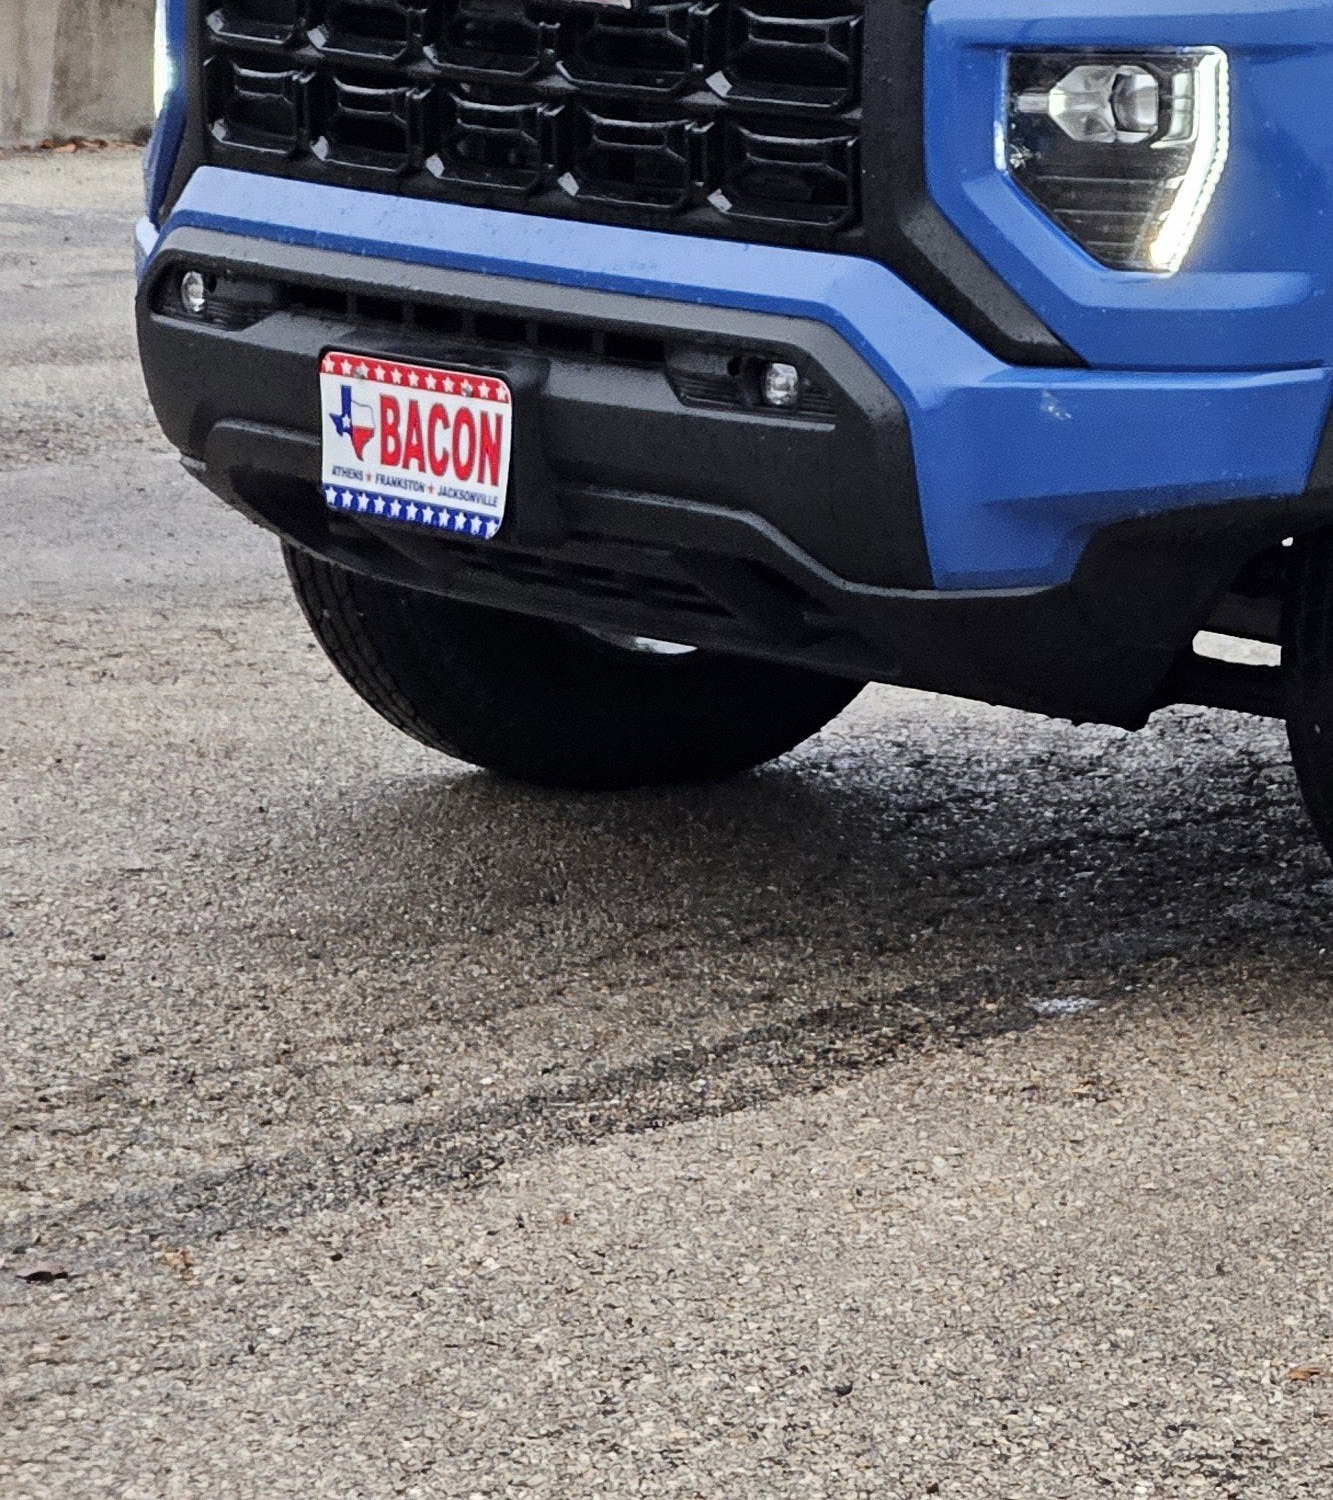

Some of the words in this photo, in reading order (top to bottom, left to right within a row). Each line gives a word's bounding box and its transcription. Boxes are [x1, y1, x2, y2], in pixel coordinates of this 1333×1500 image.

[379, 392, 504, 488] BACON
[331, 464, 364, 482] ATHENS
[374, 473, 425, 493] FRANKSTON
[437, 485, 499, 508] JACKSONVILLE
